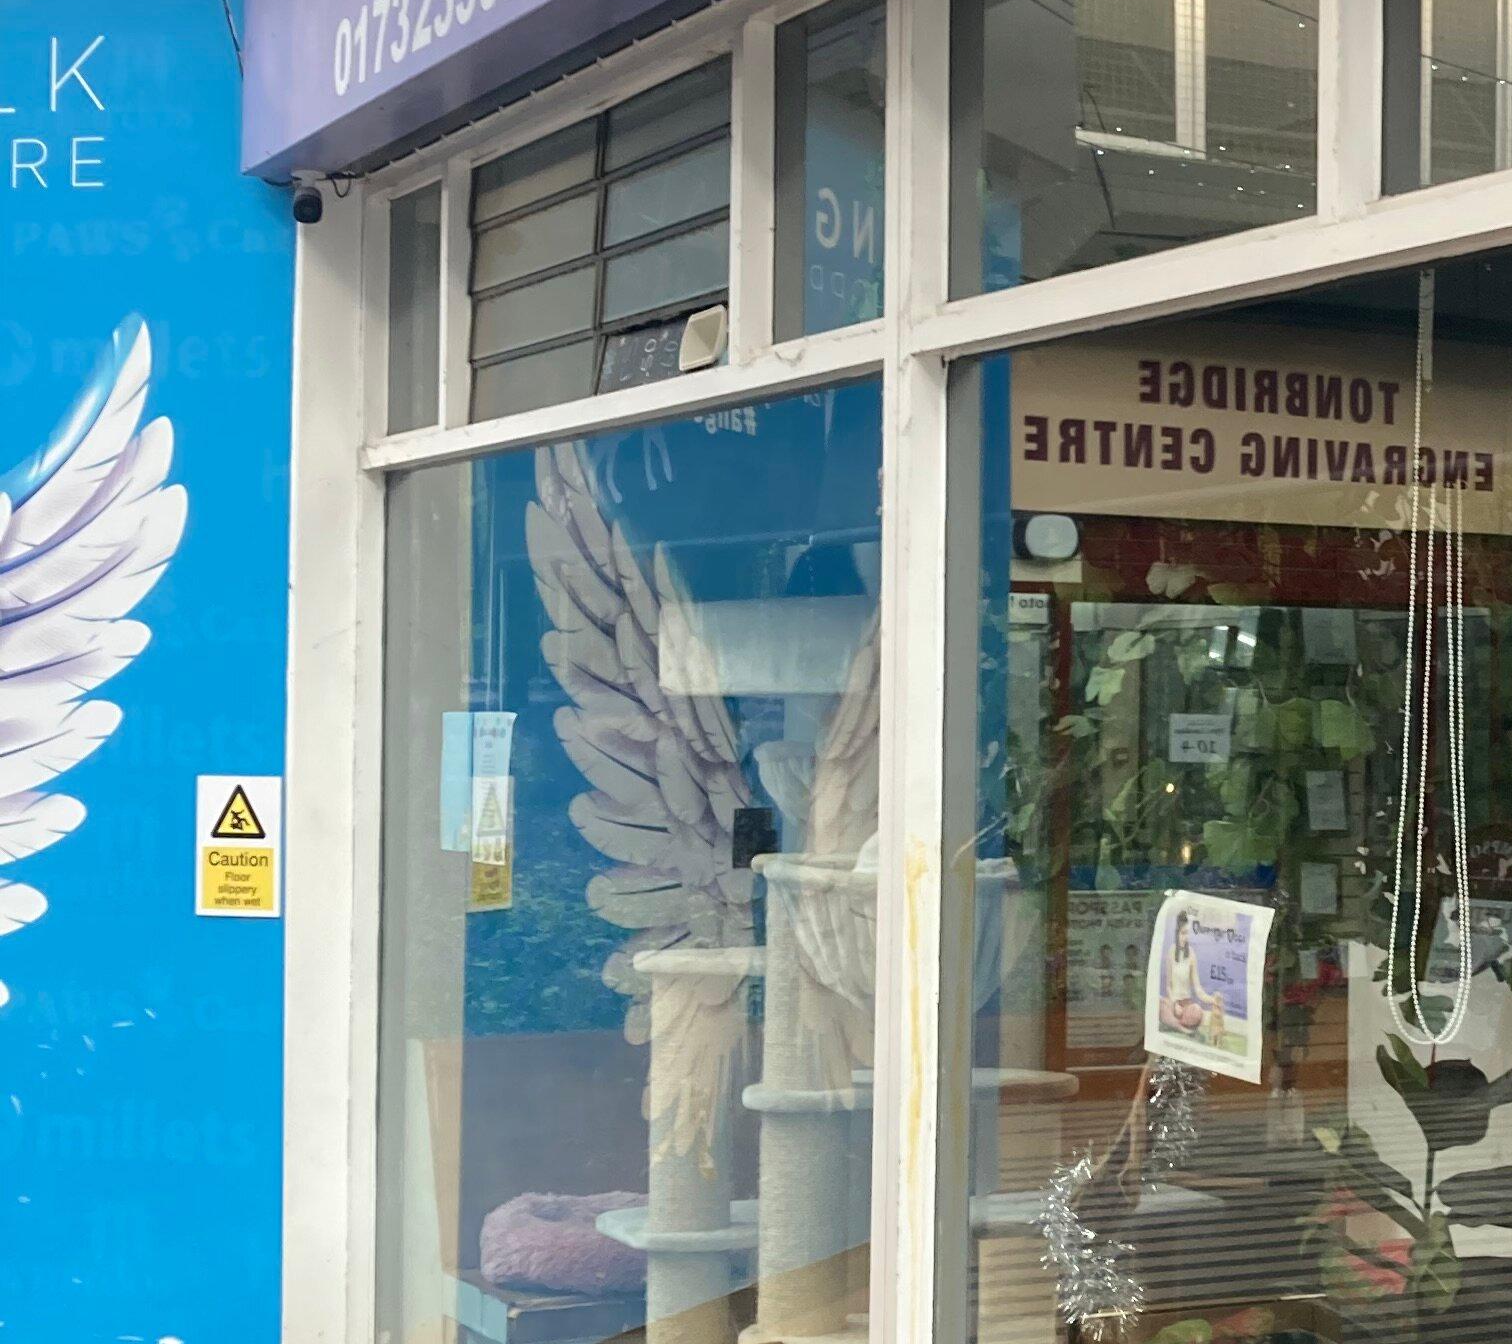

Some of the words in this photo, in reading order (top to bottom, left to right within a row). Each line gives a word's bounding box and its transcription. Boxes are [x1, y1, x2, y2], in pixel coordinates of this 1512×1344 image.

[208, 851, 269, 867] Caution
[224, 871, 251, 882] Floor
[218, 884, 257, 896] slippery
[214, 896, 241, 906] when
[243, 897, 261, 907] wet
